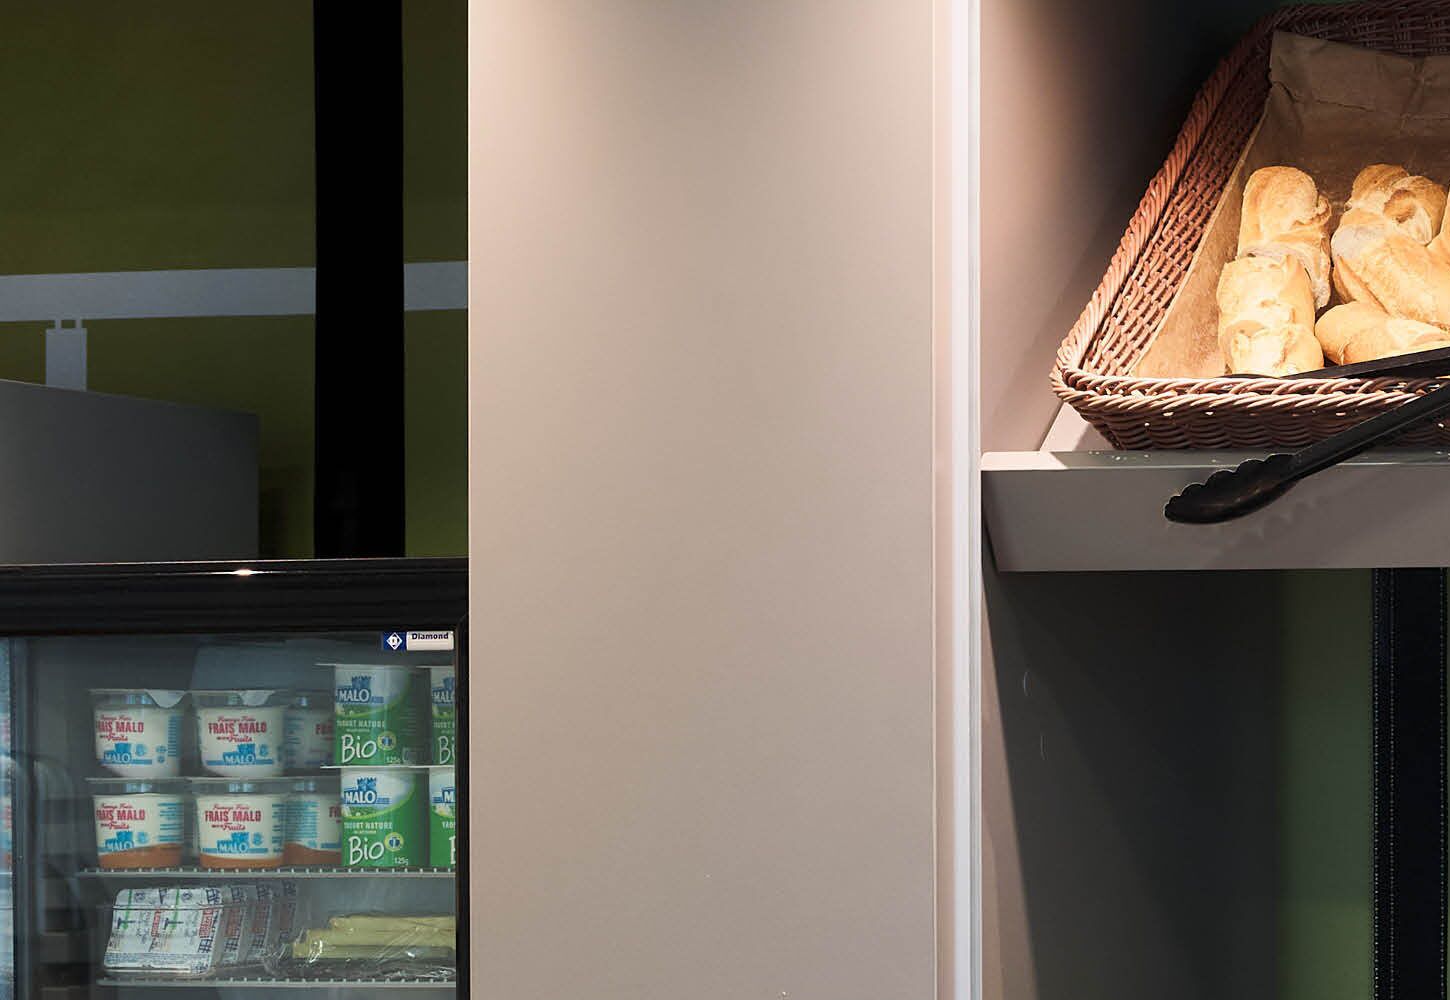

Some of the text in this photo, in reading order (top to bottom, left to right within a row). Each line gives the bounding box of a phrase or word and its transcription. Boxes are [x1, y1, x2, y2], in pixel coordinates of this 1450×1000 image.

[412, 632, 449, 640] Diamond
[339, 688, 370, 702] MALO
[116, 721, 144, 733] MALO
[208, 721, 267, 734] FRAIS MALO
[341, 734, 377, 763] Bio
[438, 735, 455, 764] Bi
[104, 752, 131, 764] MALO
[224, 753, 255, 765] MALO
[345, 790, 377, 804] MALO
[117, 809, 145, 821] MALO
[205, 810, 262, 822] FRAIS MALO
[105, 840, 134, 852] MALO
[218, 842, 249, 854] MALO
[348, 835, 385, 865] Bio
